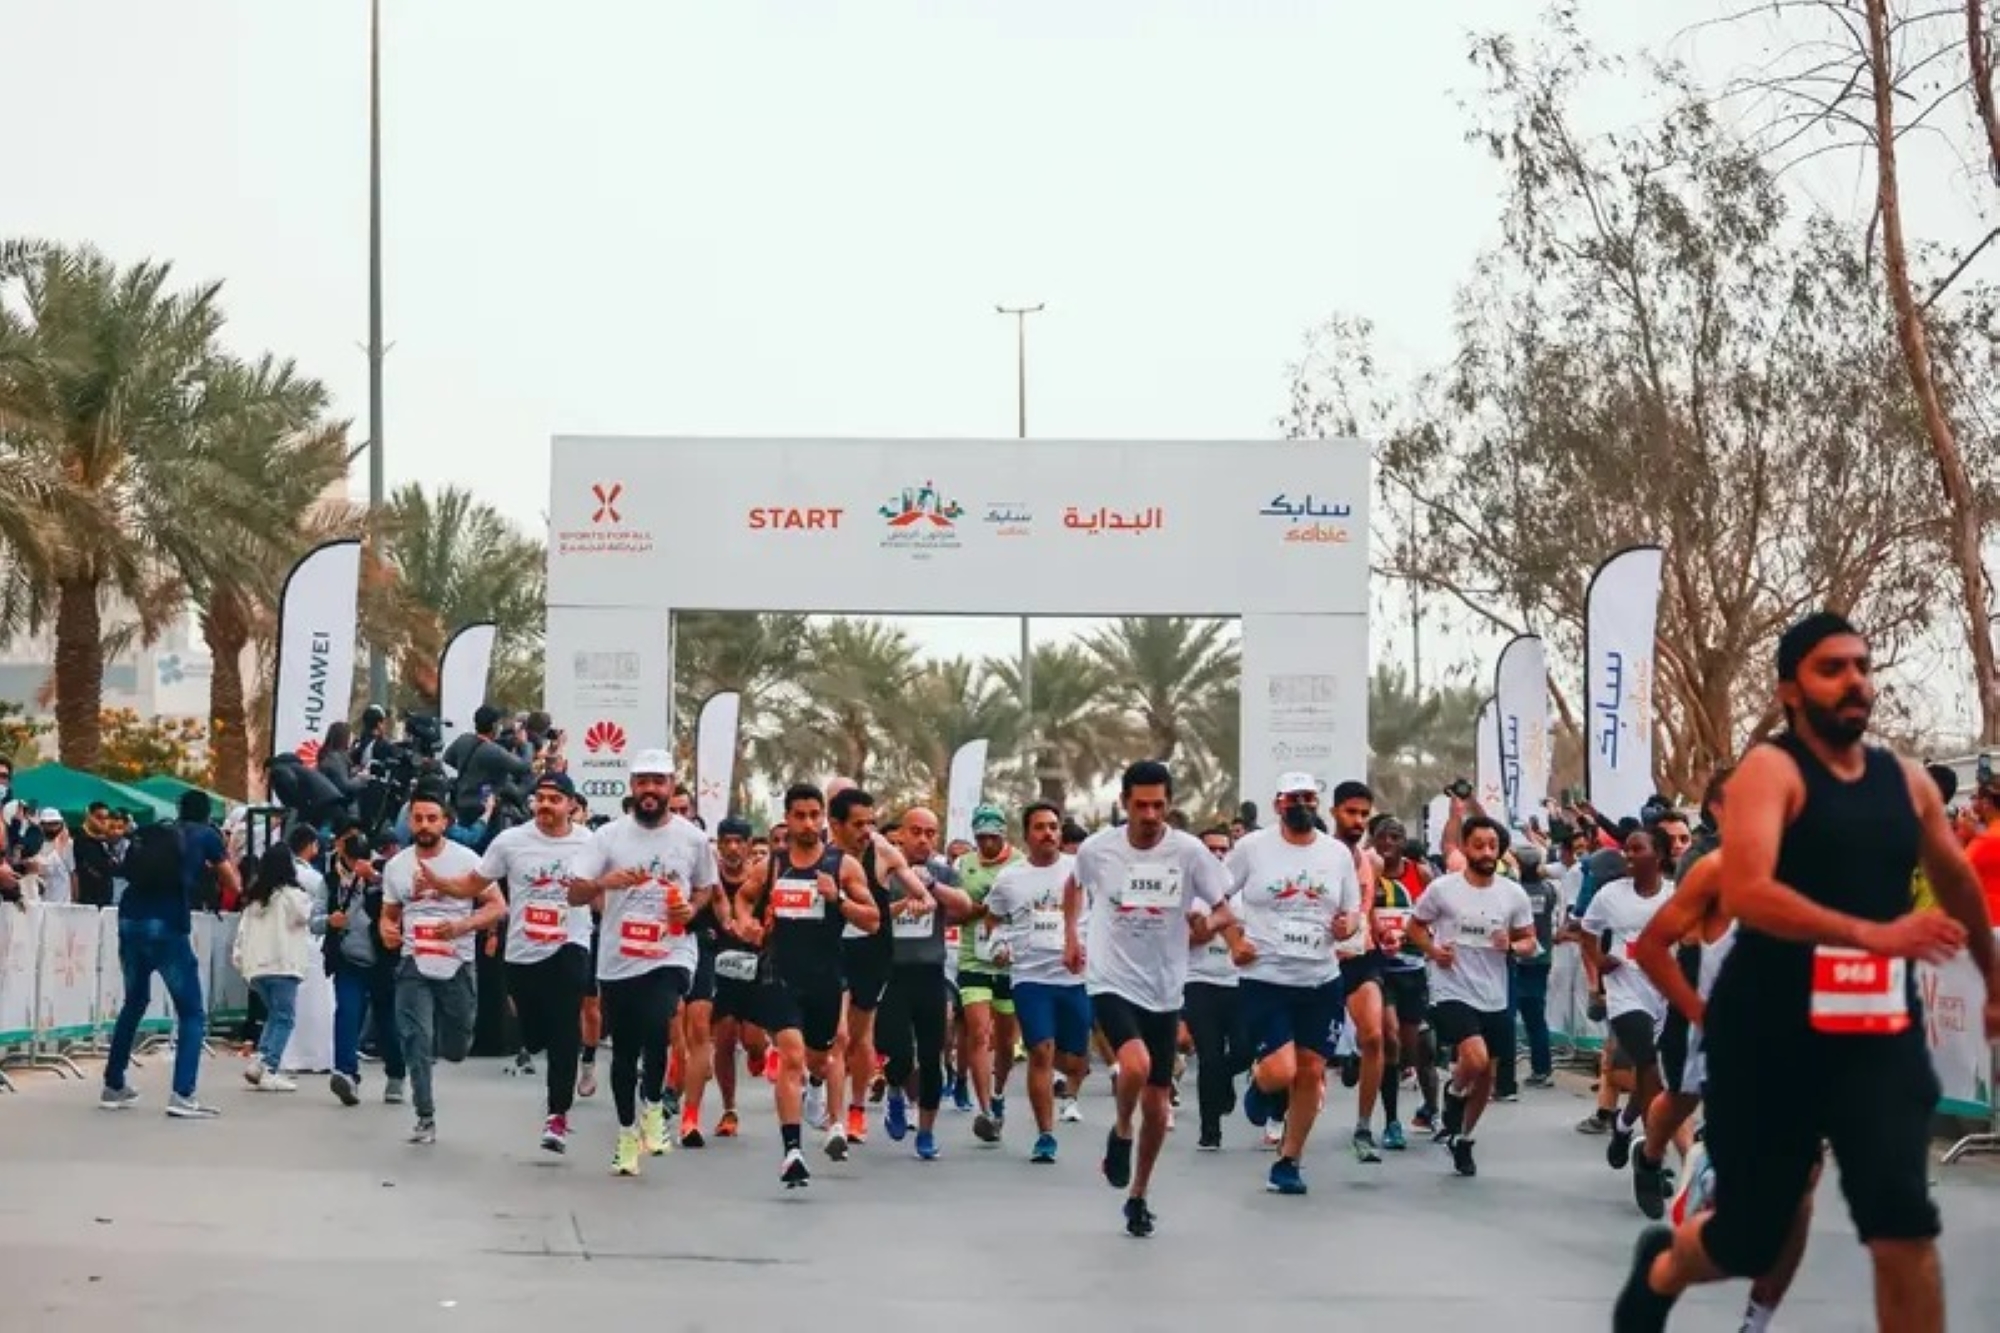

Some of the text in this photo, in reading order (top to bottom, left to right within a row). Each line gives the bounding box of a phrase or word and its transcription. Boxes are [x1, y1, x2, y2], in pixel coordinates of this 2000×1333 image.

[748, 508, 843, 528] START
[1063, 507, 1162, 535] البداية
[1260, 495, 1350, 522] سابك
[1284, 522, 1352, 542] sabic
[305, 632, 330, 733] HUAWEI
[1596, 652, 1626, 769] سابك
